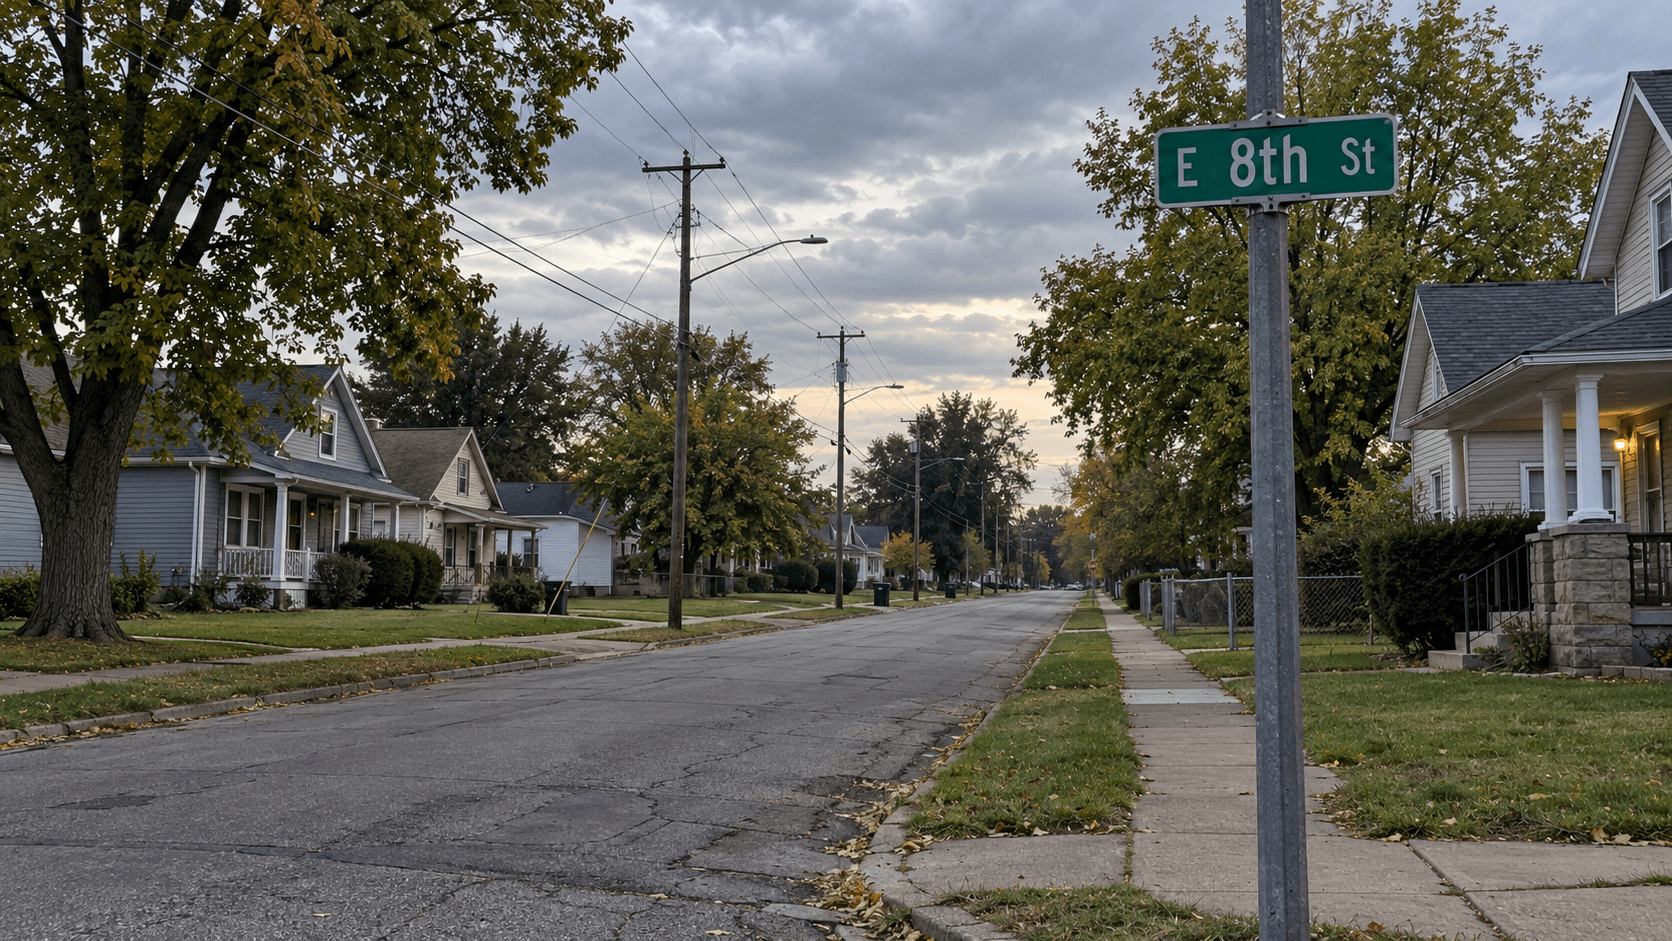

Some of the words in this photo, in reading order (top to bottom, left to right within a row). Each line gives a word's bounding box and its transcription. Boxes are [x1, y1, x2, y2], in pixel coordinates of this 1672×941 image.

[1177, 147, 1198, 188] E
[1230, 134, 1308, 188] 8th
[1340, 137, 1376, 175] St
